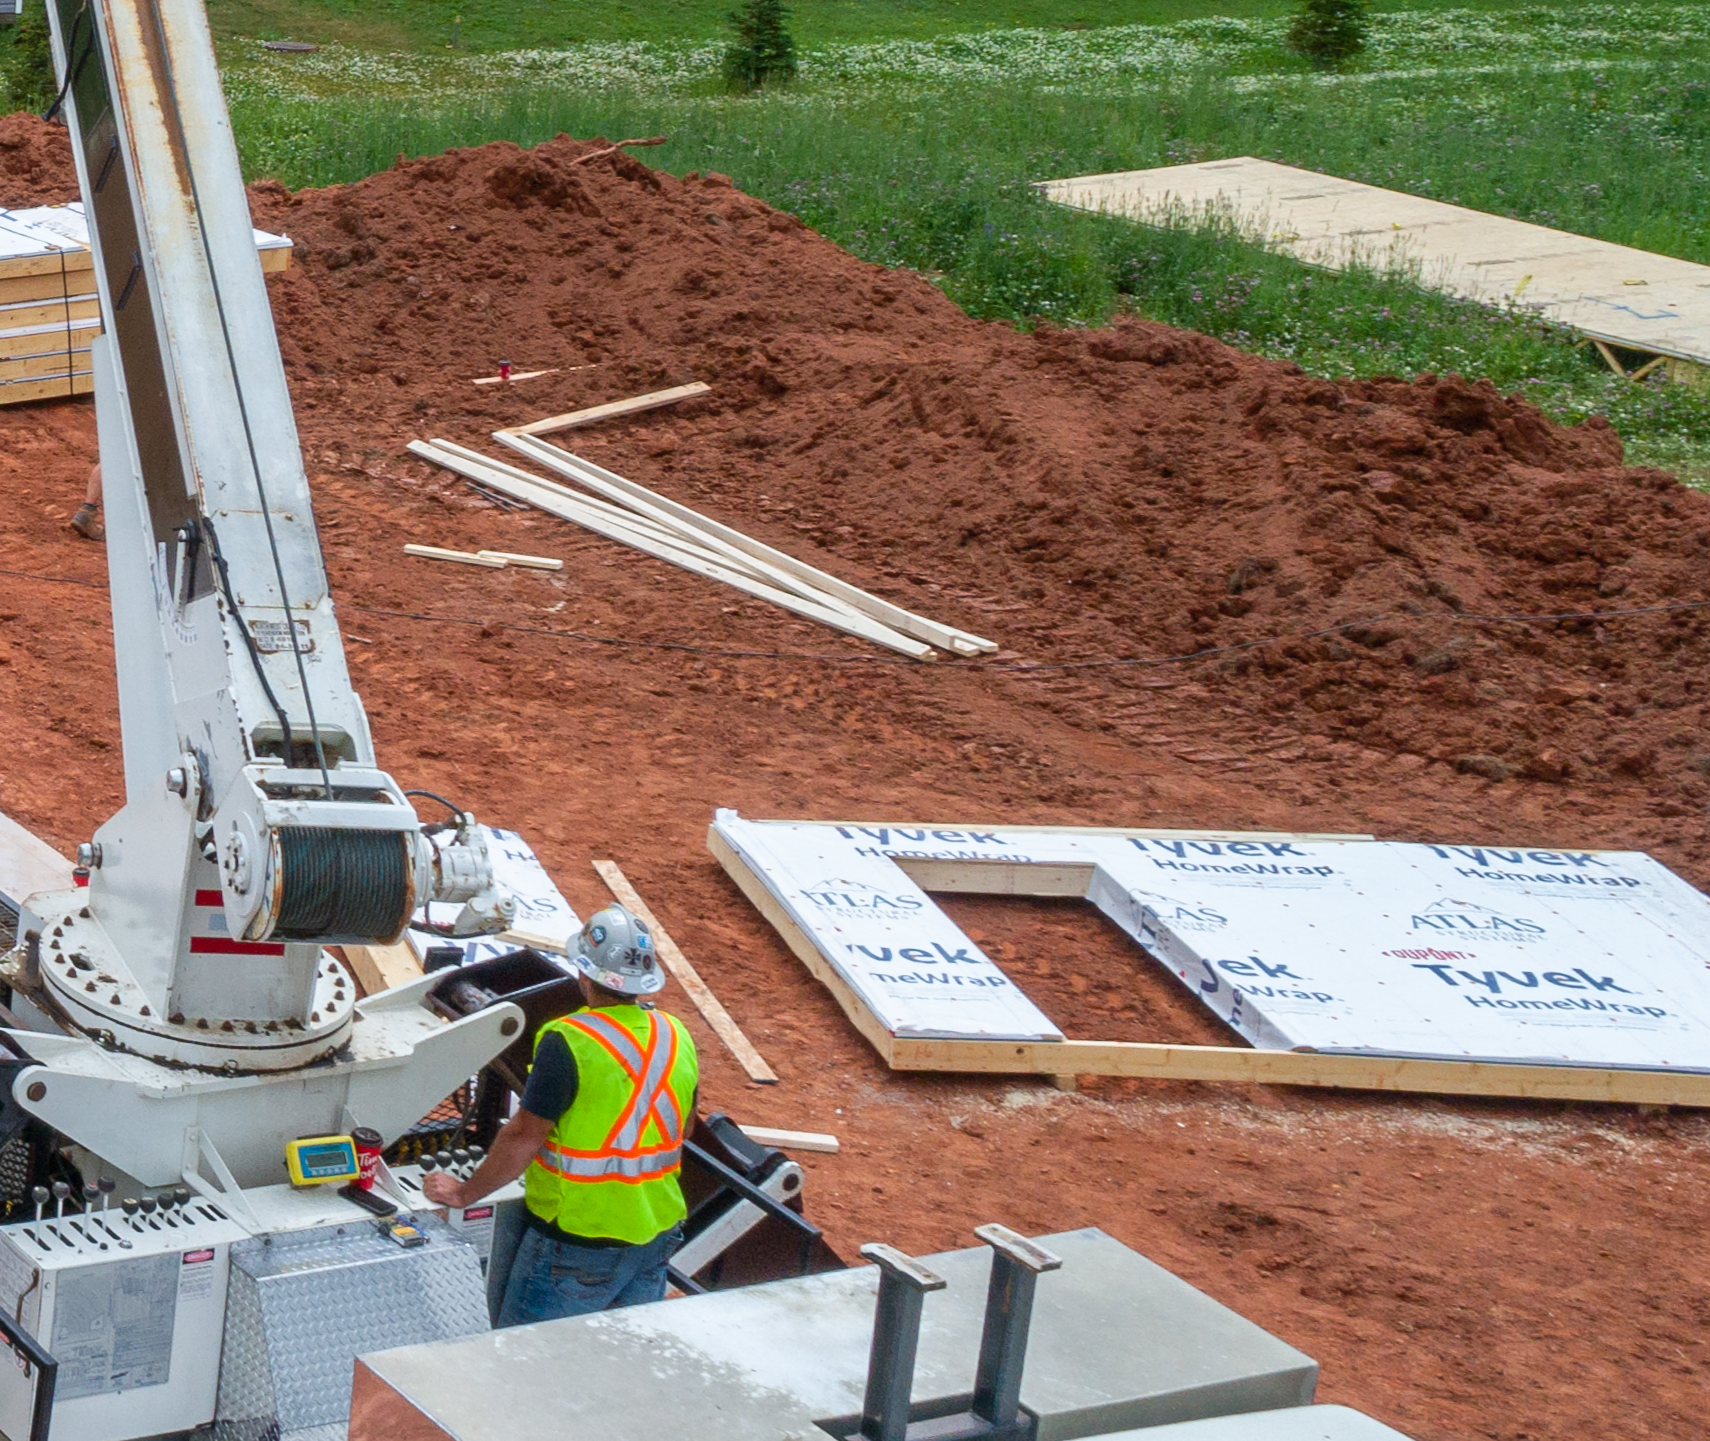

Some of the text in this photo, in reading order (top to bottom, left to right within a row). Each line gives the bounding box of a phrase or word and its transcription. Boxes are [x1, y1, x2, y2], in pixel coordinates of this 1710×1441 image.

[1152, 858, 1335, 877] HomeWrap
[1454, 867, 1641, 888] HomeWrap
[1410, 914, 1547, 934] ATLAS
[1389, 947, 1469, 961] DUPONT
[1410, 963, 1635, 993] Tyvek
[1463, 995, 1667, 1018] HomeWrap
